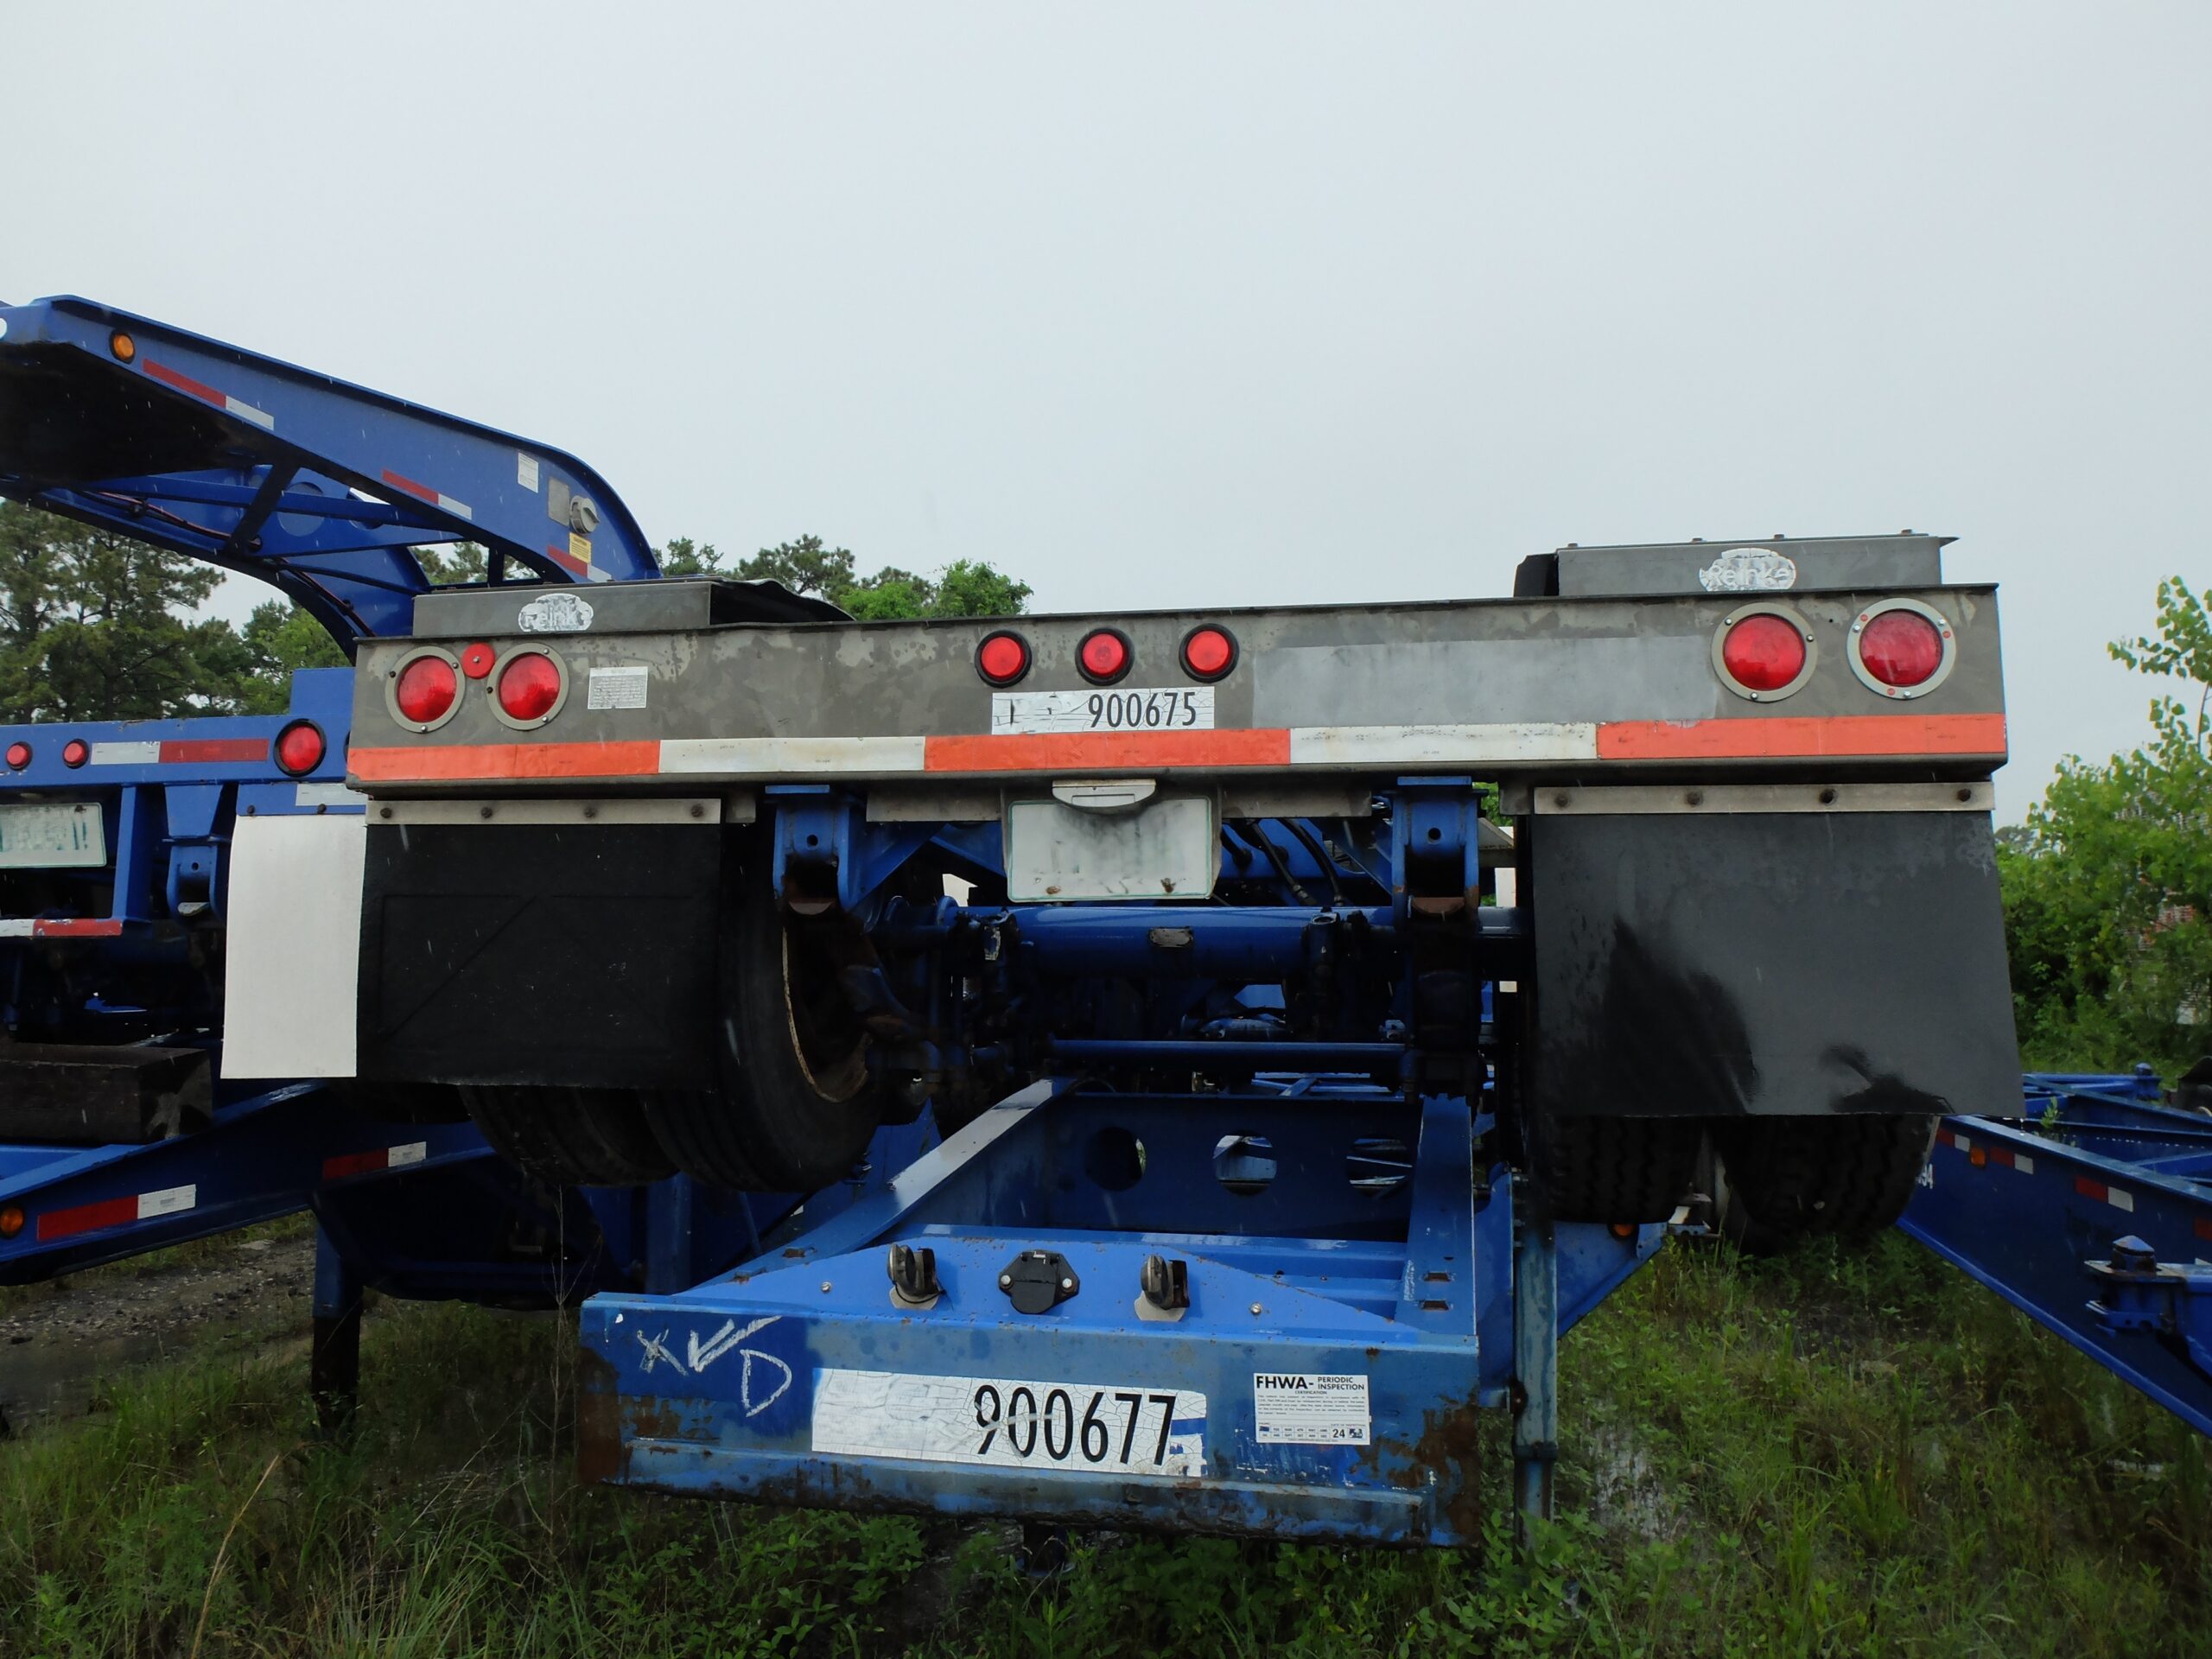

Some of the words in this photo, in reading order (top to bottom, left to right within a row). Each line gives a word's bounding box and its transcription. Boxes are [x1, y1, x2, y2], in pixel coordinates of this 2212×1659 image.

[1088, 691, 1197, 728] 900675
[974, 1384, 1176, 1465] 900677
[1332, 1428, 1345, 1439] 24
